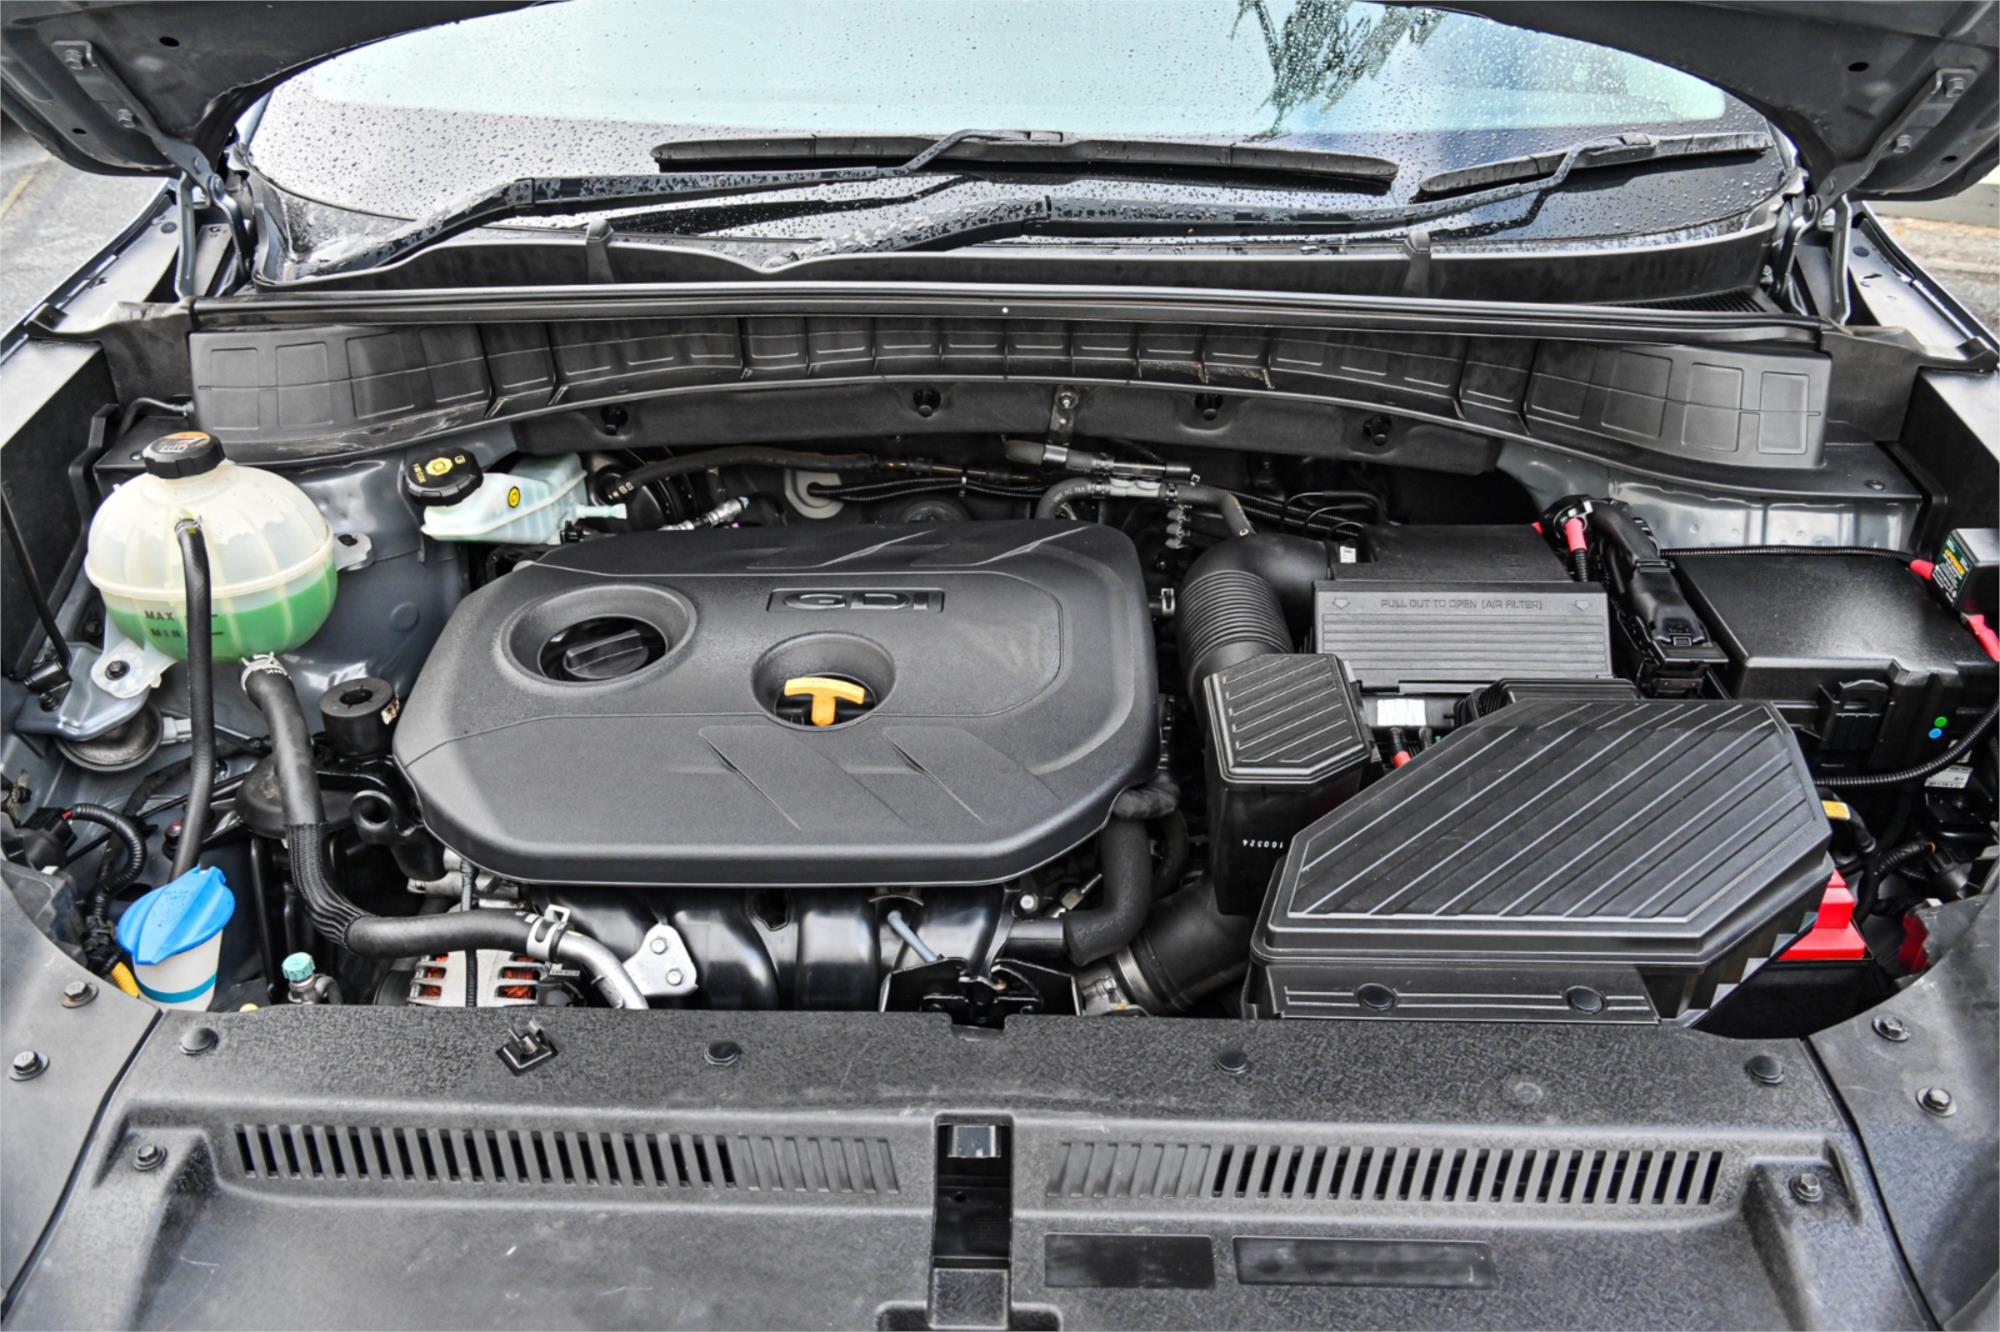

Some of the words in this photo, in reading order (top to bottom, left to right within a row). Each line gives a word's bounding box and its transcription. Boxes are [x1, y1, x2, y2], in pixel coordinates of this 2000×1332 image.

[784, 592, 929, 610] GDI
[1381, 599, 1407, 608] PULL
[1409, 599, 1430, 608] OUT
[1432, 599, 1447, 608] TO
[1449, 599, 1477, 609] OPEN
[144, 610, 174, 621] MAX
[151, 628, 182, 638] MIN
